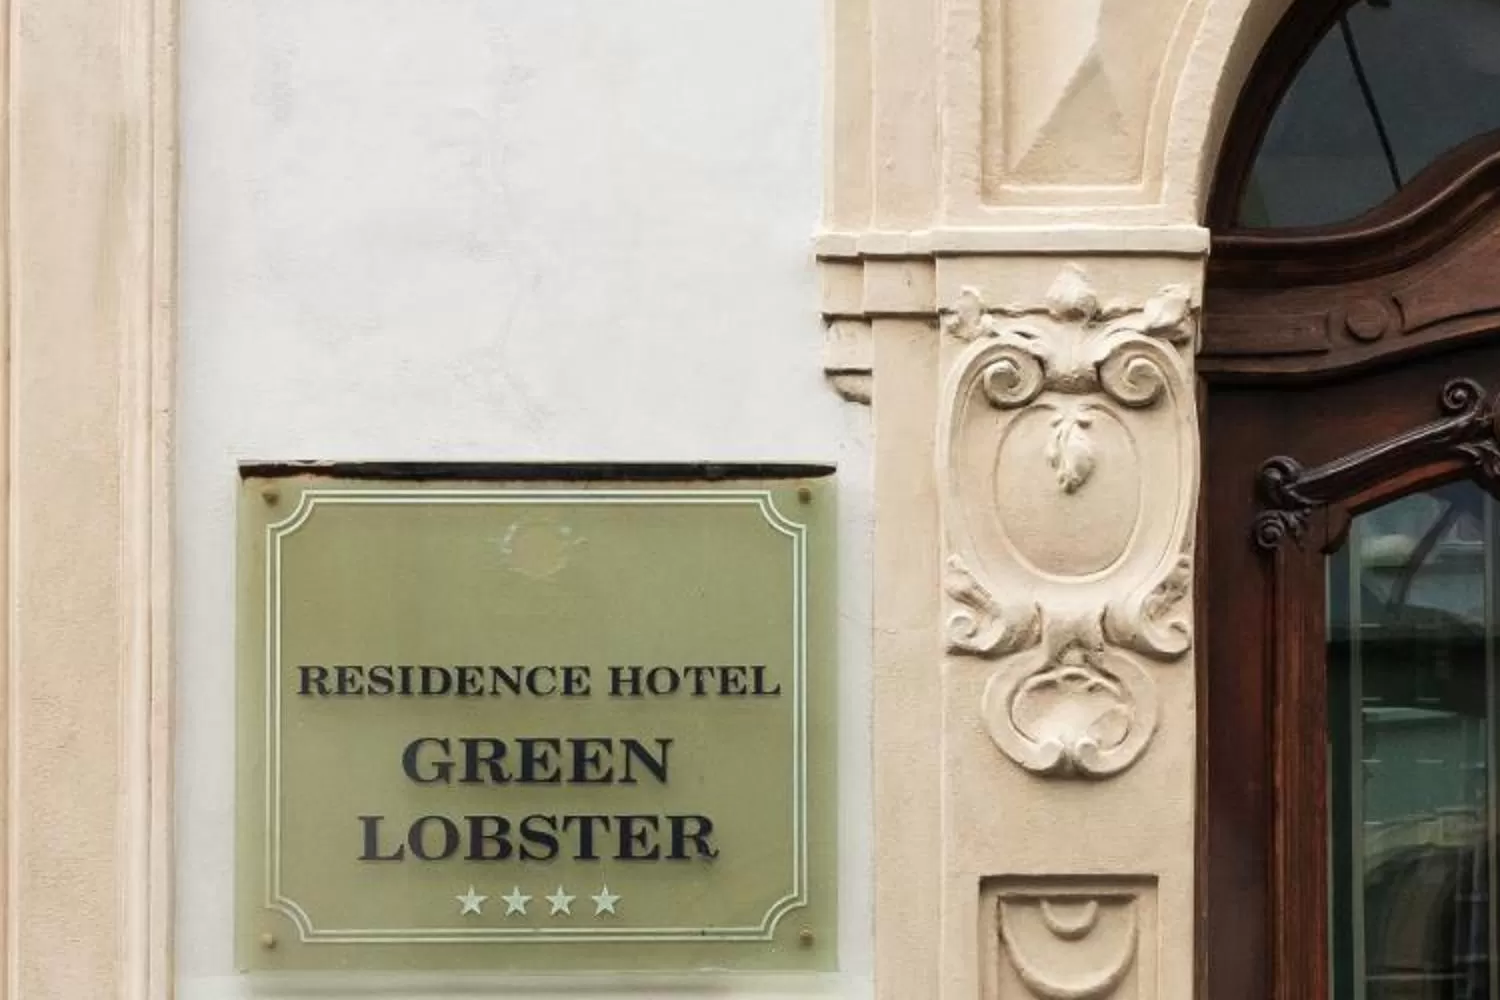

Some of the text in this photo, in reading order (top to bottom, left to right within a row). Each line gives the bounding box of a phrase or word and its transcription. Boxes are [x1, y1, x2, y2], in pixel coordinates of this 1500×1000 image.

[297, 665, 782, 697] RESIDENCE HOTEL
[402, 736, 674, 786] GREEN
[357, 814, 719, 863] LOBSTER
